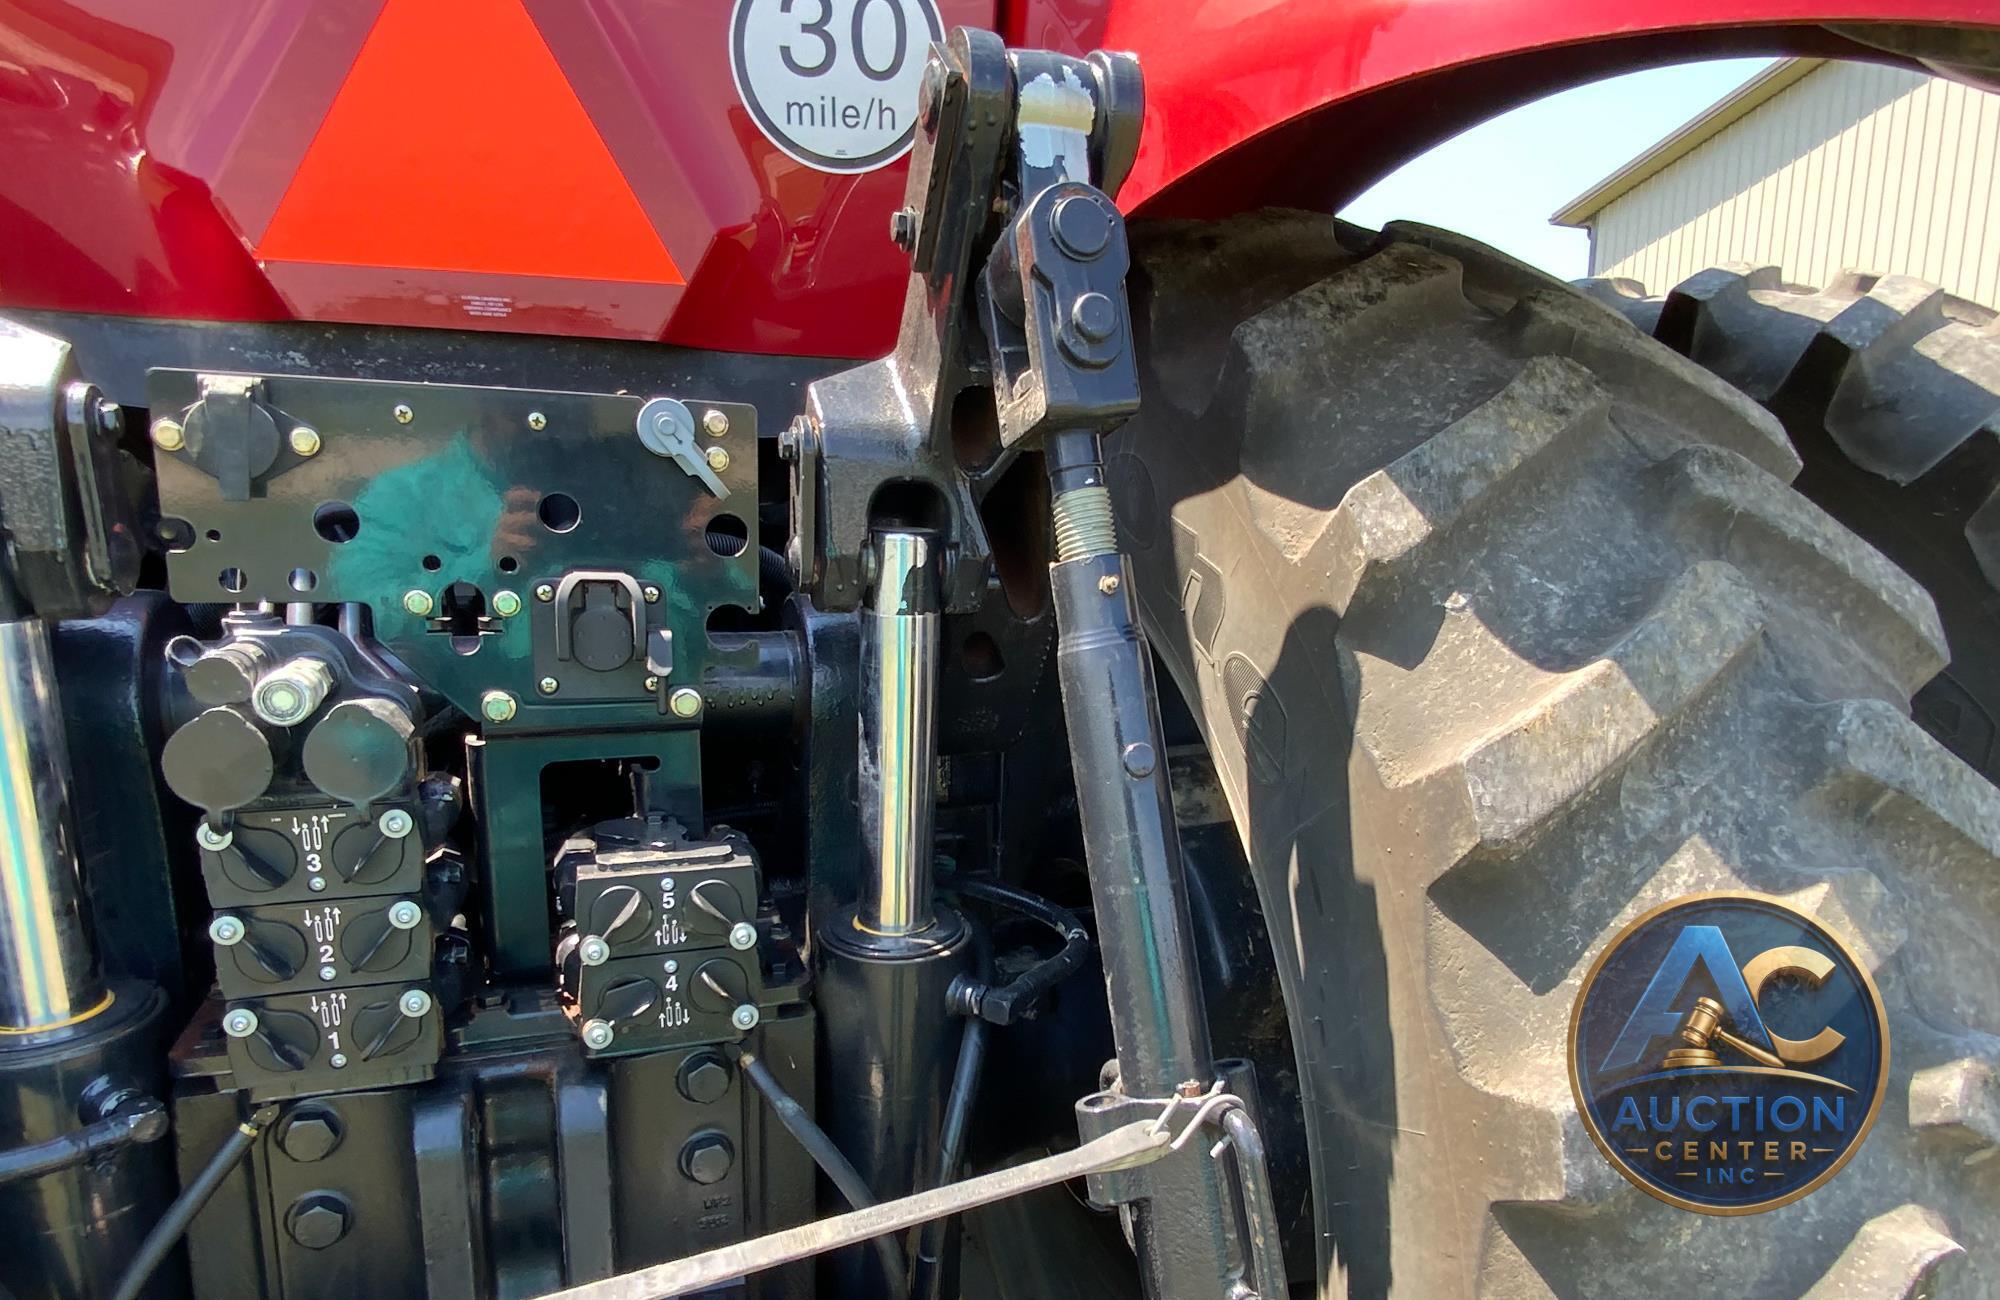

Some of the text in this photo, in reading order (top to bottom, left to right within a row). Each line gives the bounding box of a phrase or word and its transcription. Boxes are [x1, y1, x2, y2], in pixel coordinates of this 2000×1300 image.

[779, 0, 907, 82] 30
[786, 95, 897, 131] mile/h
[306, 853, 323, 873] 3
[662, 892, 675, 909] 5
[319, 945, 335, 963] 2
[665, 975, 679, 992] 4
[327, 1031, 341, 1050] 1
